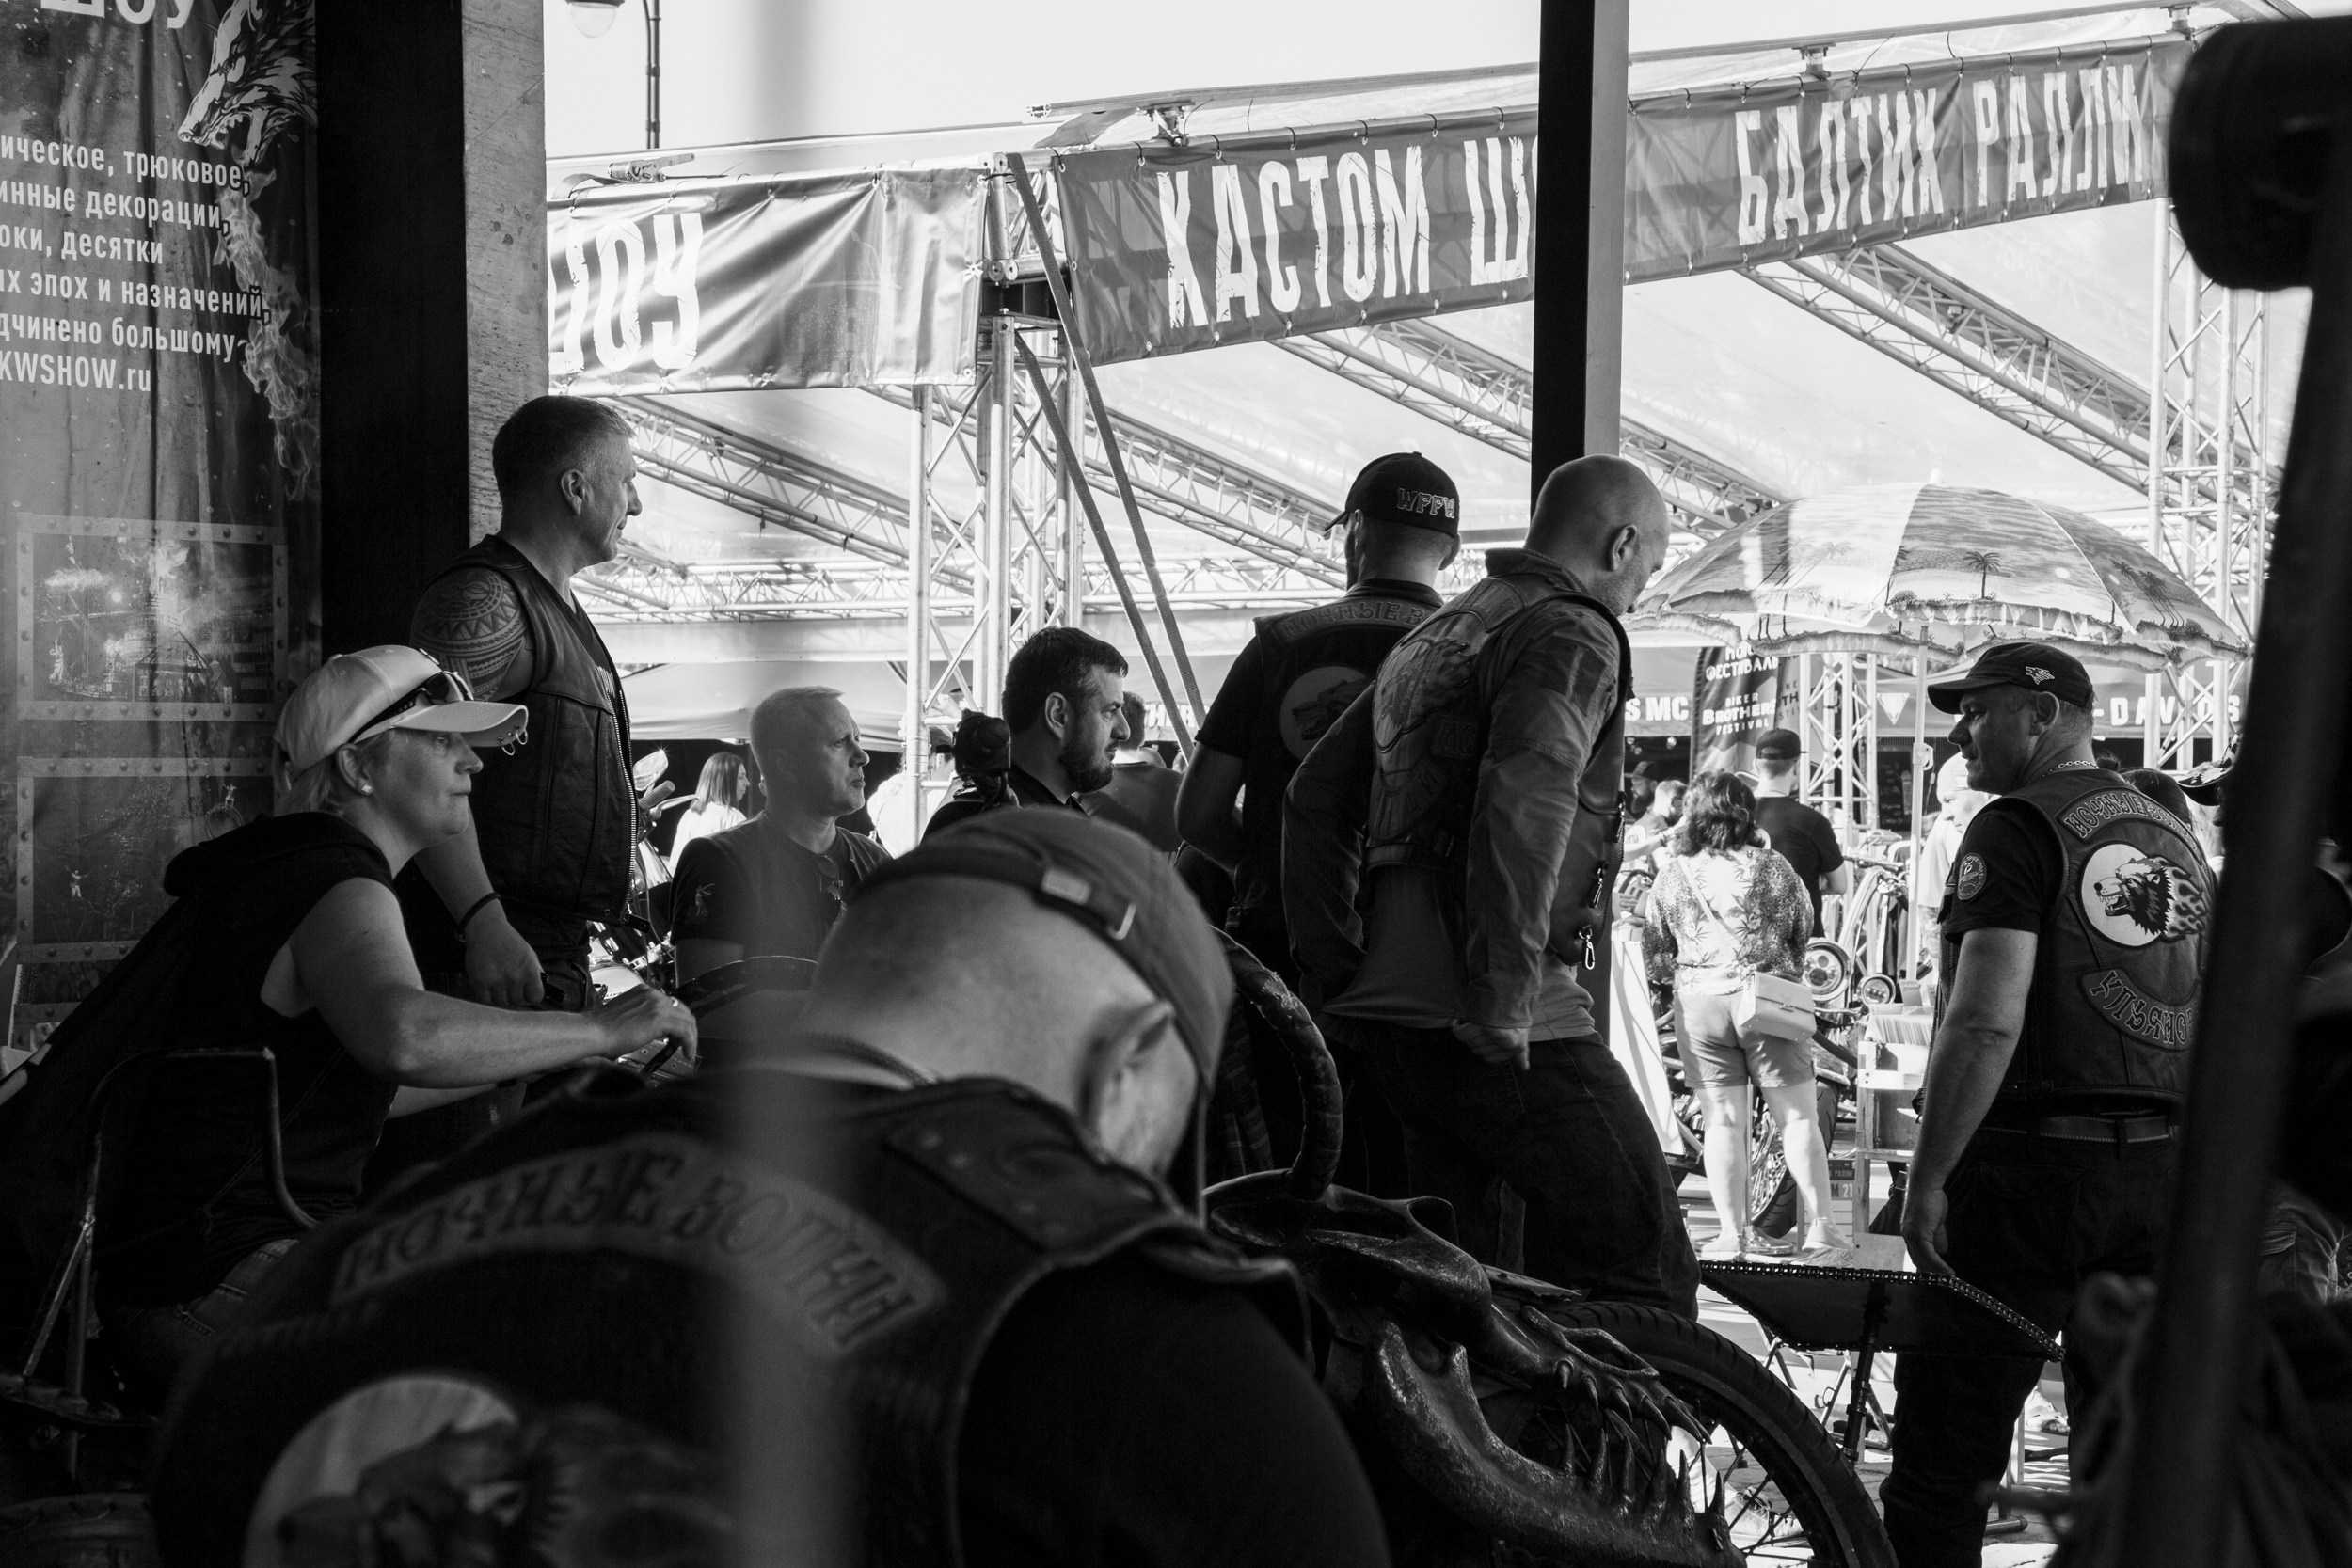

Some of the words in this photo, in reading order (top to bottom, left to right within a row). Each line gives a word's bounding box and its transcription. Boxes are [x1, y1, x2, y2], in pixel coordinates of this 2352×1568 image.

[123, 150, 250, 195] трюковое,
[1735, 88, 1944, 245] БАЛТИК
[1973, 64, 2143, 207] РАЛЛИ
[86, 190, 230, 235] декорации,
[1156, 145, 1431, 328] КАСТОМ
[1463, 135, 1538, 286] Ш
[61, 231, 163, 264] десятки
[30, 271, 88, 300] эпох
[98, 278, 111, 302] и
[121, 280, 271, 325] назначений,
[111, 316, 235, 363] большому
[1645, 696, 1689, 721] MC
[2064, 793, 2149, 838] НОЧНЫЕ
